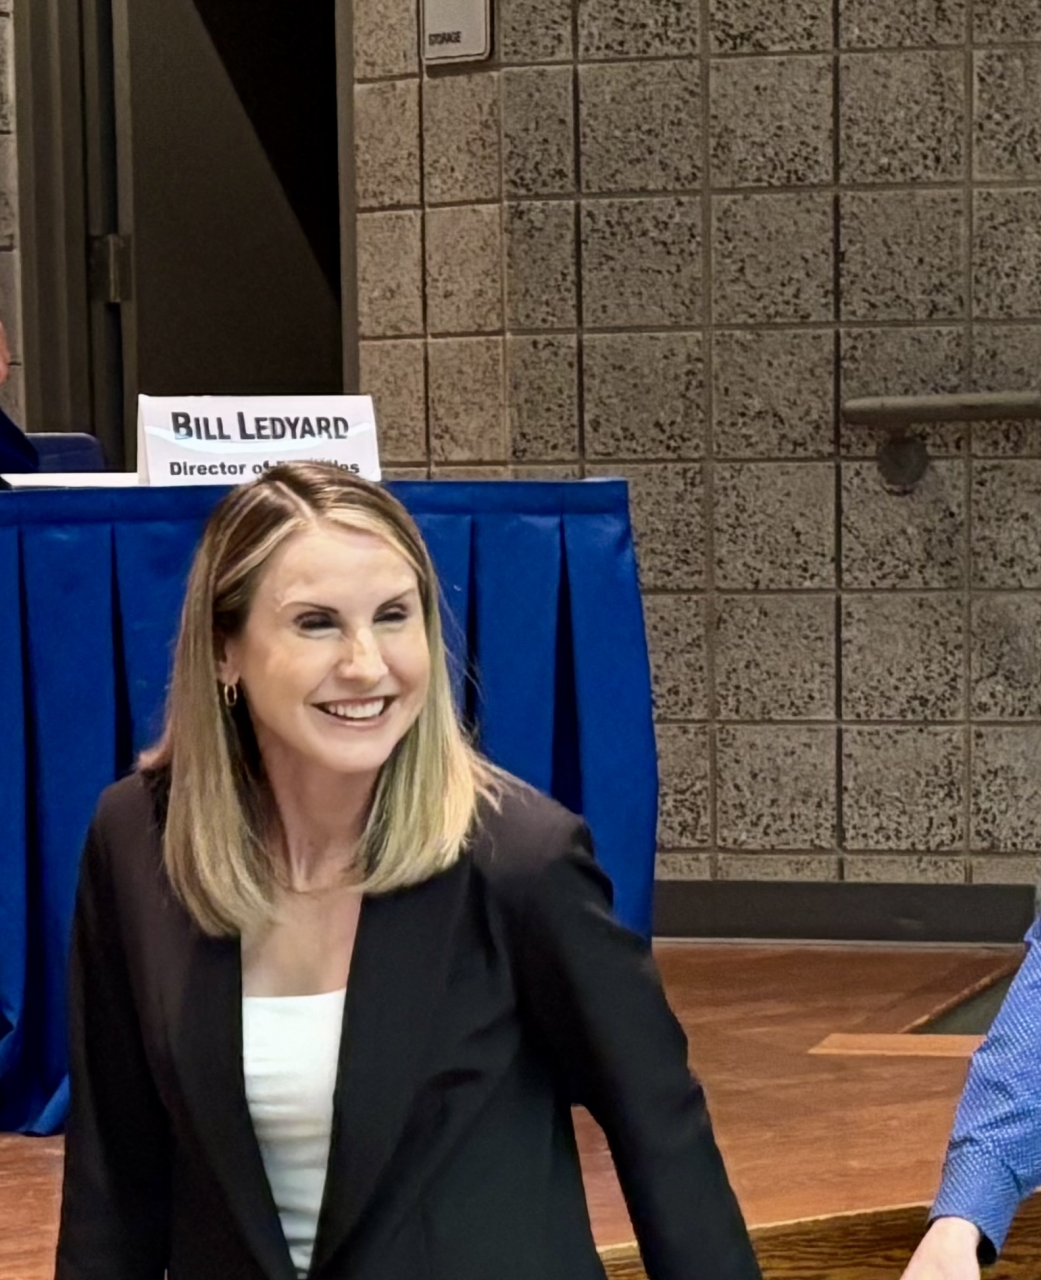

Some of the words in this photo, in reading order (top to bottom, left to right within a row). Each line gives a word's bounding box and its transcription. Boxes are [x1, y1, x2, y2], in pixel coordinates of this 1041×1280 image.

[171, 411, 231, 440] BILL
[236, 411, 349, 440] LEDYARD
[169, 461, 247, 476] Director
